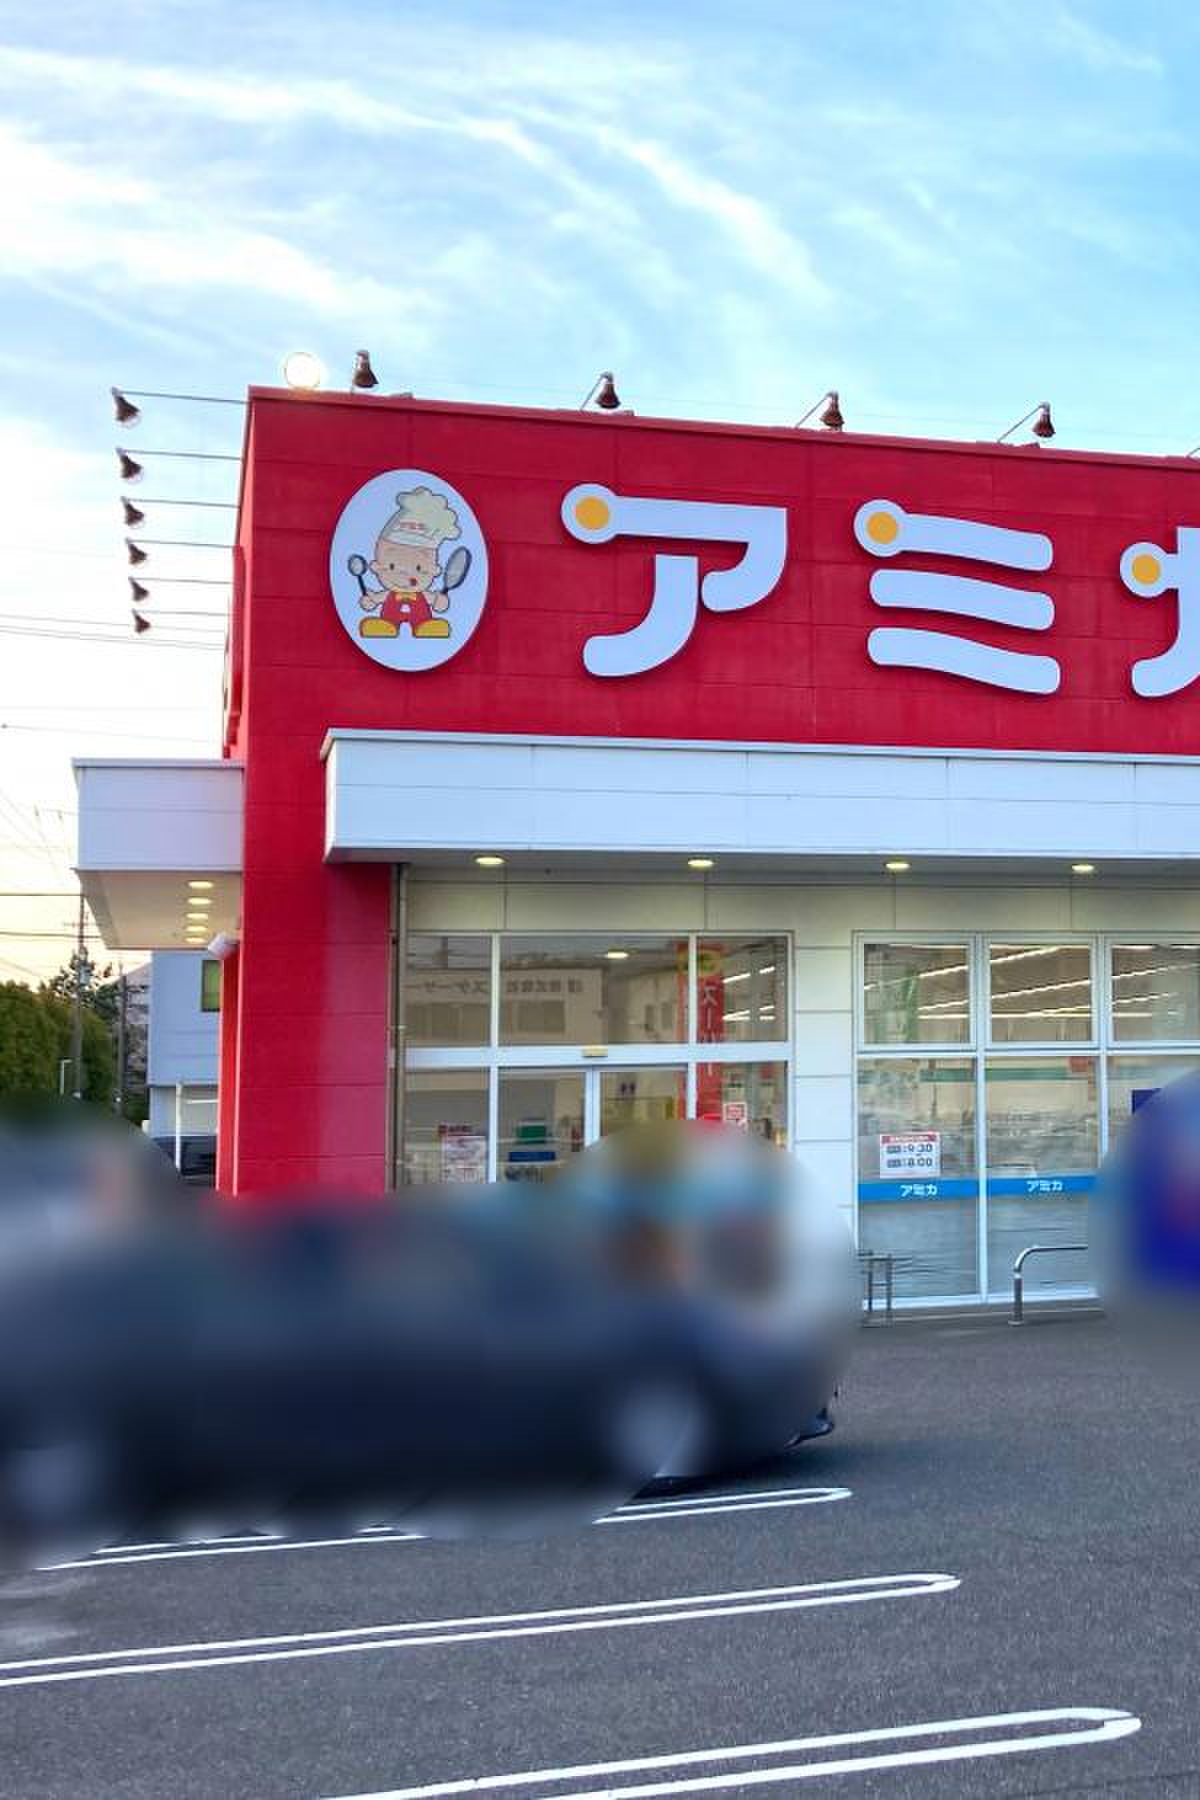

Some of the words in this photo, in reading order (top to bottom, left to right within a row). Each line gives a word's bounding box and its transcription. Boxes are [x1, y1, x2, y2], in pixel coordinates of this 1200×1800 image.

[900, 1184, 938, 1197] アミカ
[1026, 1180, 1063, 1192] アミカ
